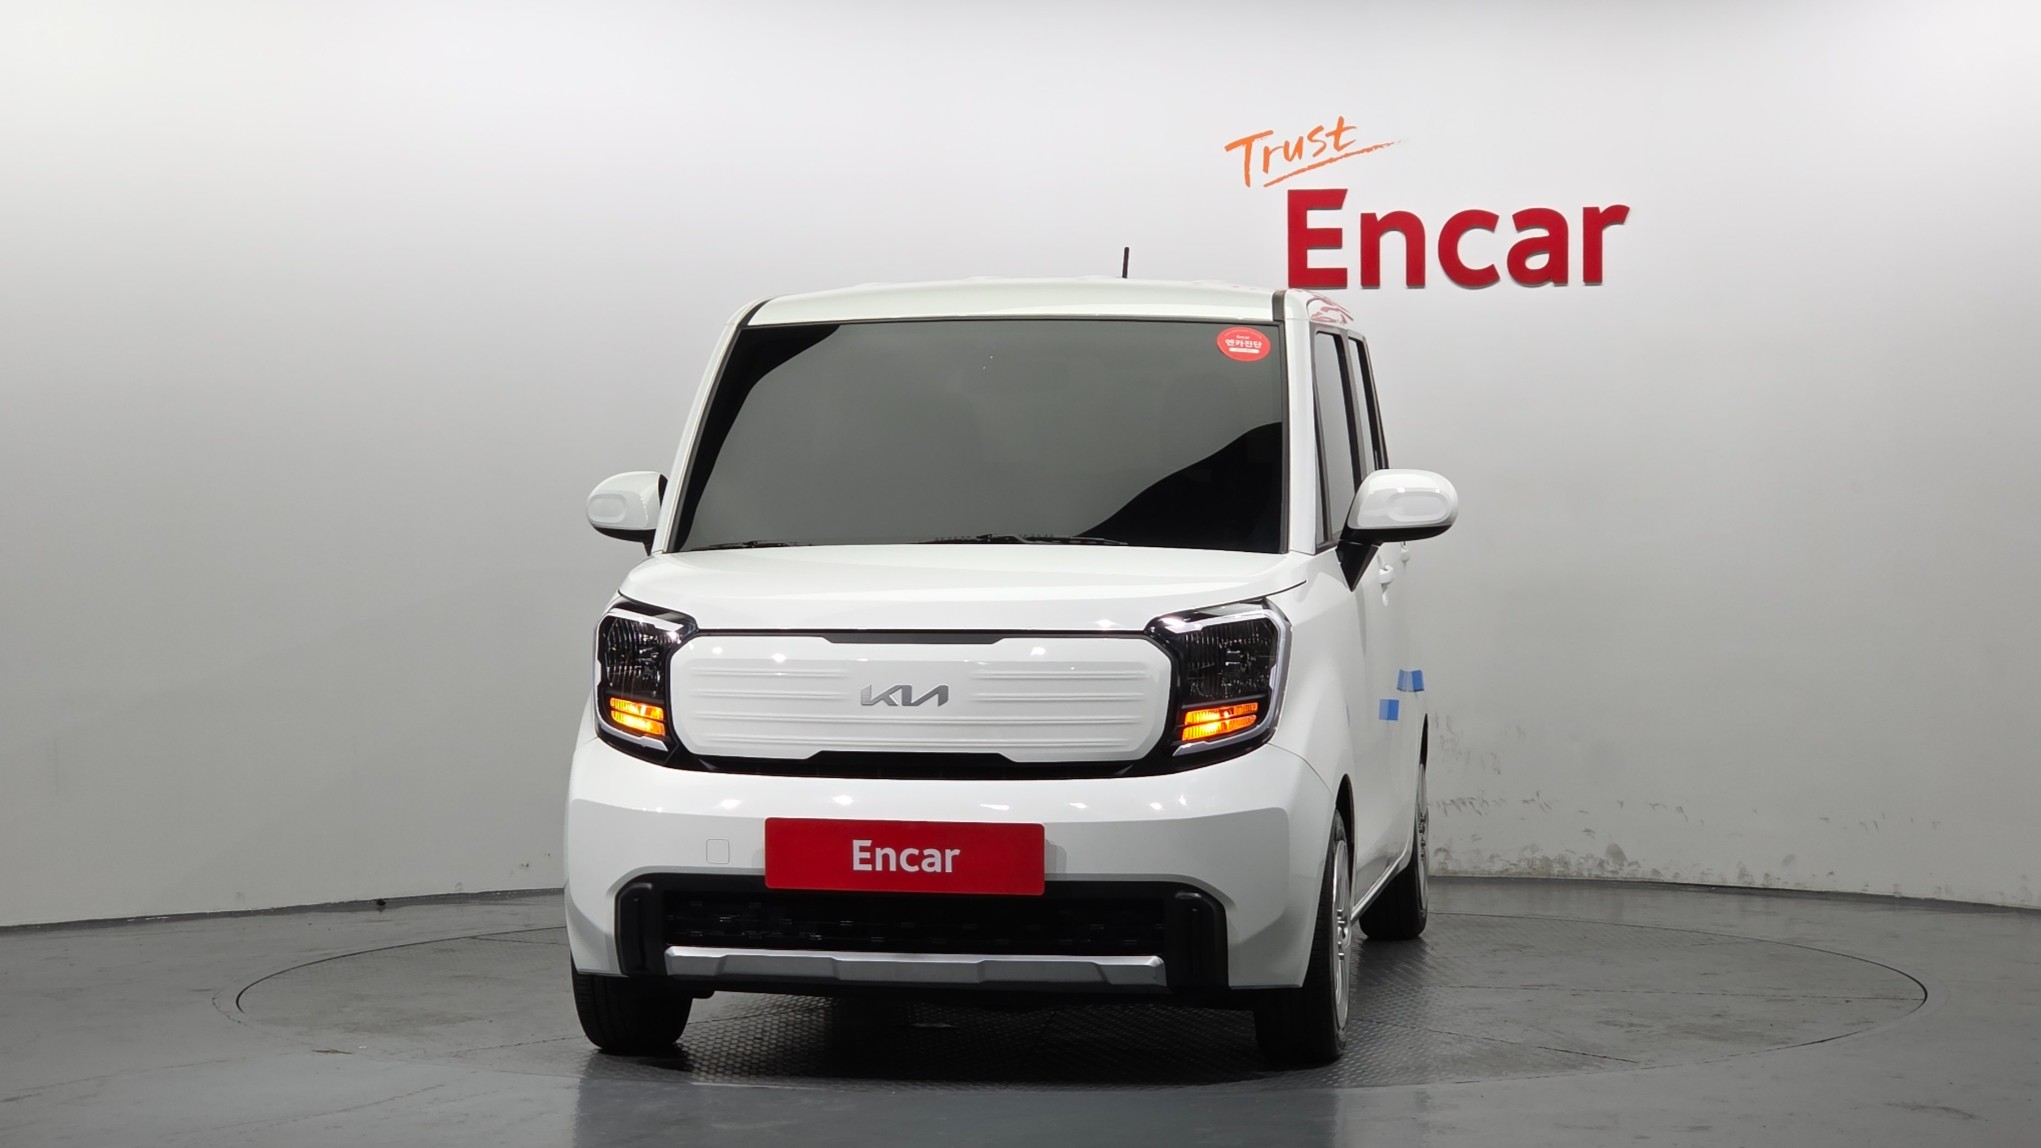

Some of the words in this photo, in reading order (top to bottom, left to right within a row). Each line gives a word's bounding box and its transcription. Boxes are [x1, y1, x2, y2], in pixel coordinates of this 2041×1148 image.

[1224, 115, 1358, 188] Trust
[1287, 188, 1631, 290] Encar
[1225, 338, 1262, 349] 엔카진단
[860, 683, 949, 707] KIA
[852, 839, 960, 873] Encar
